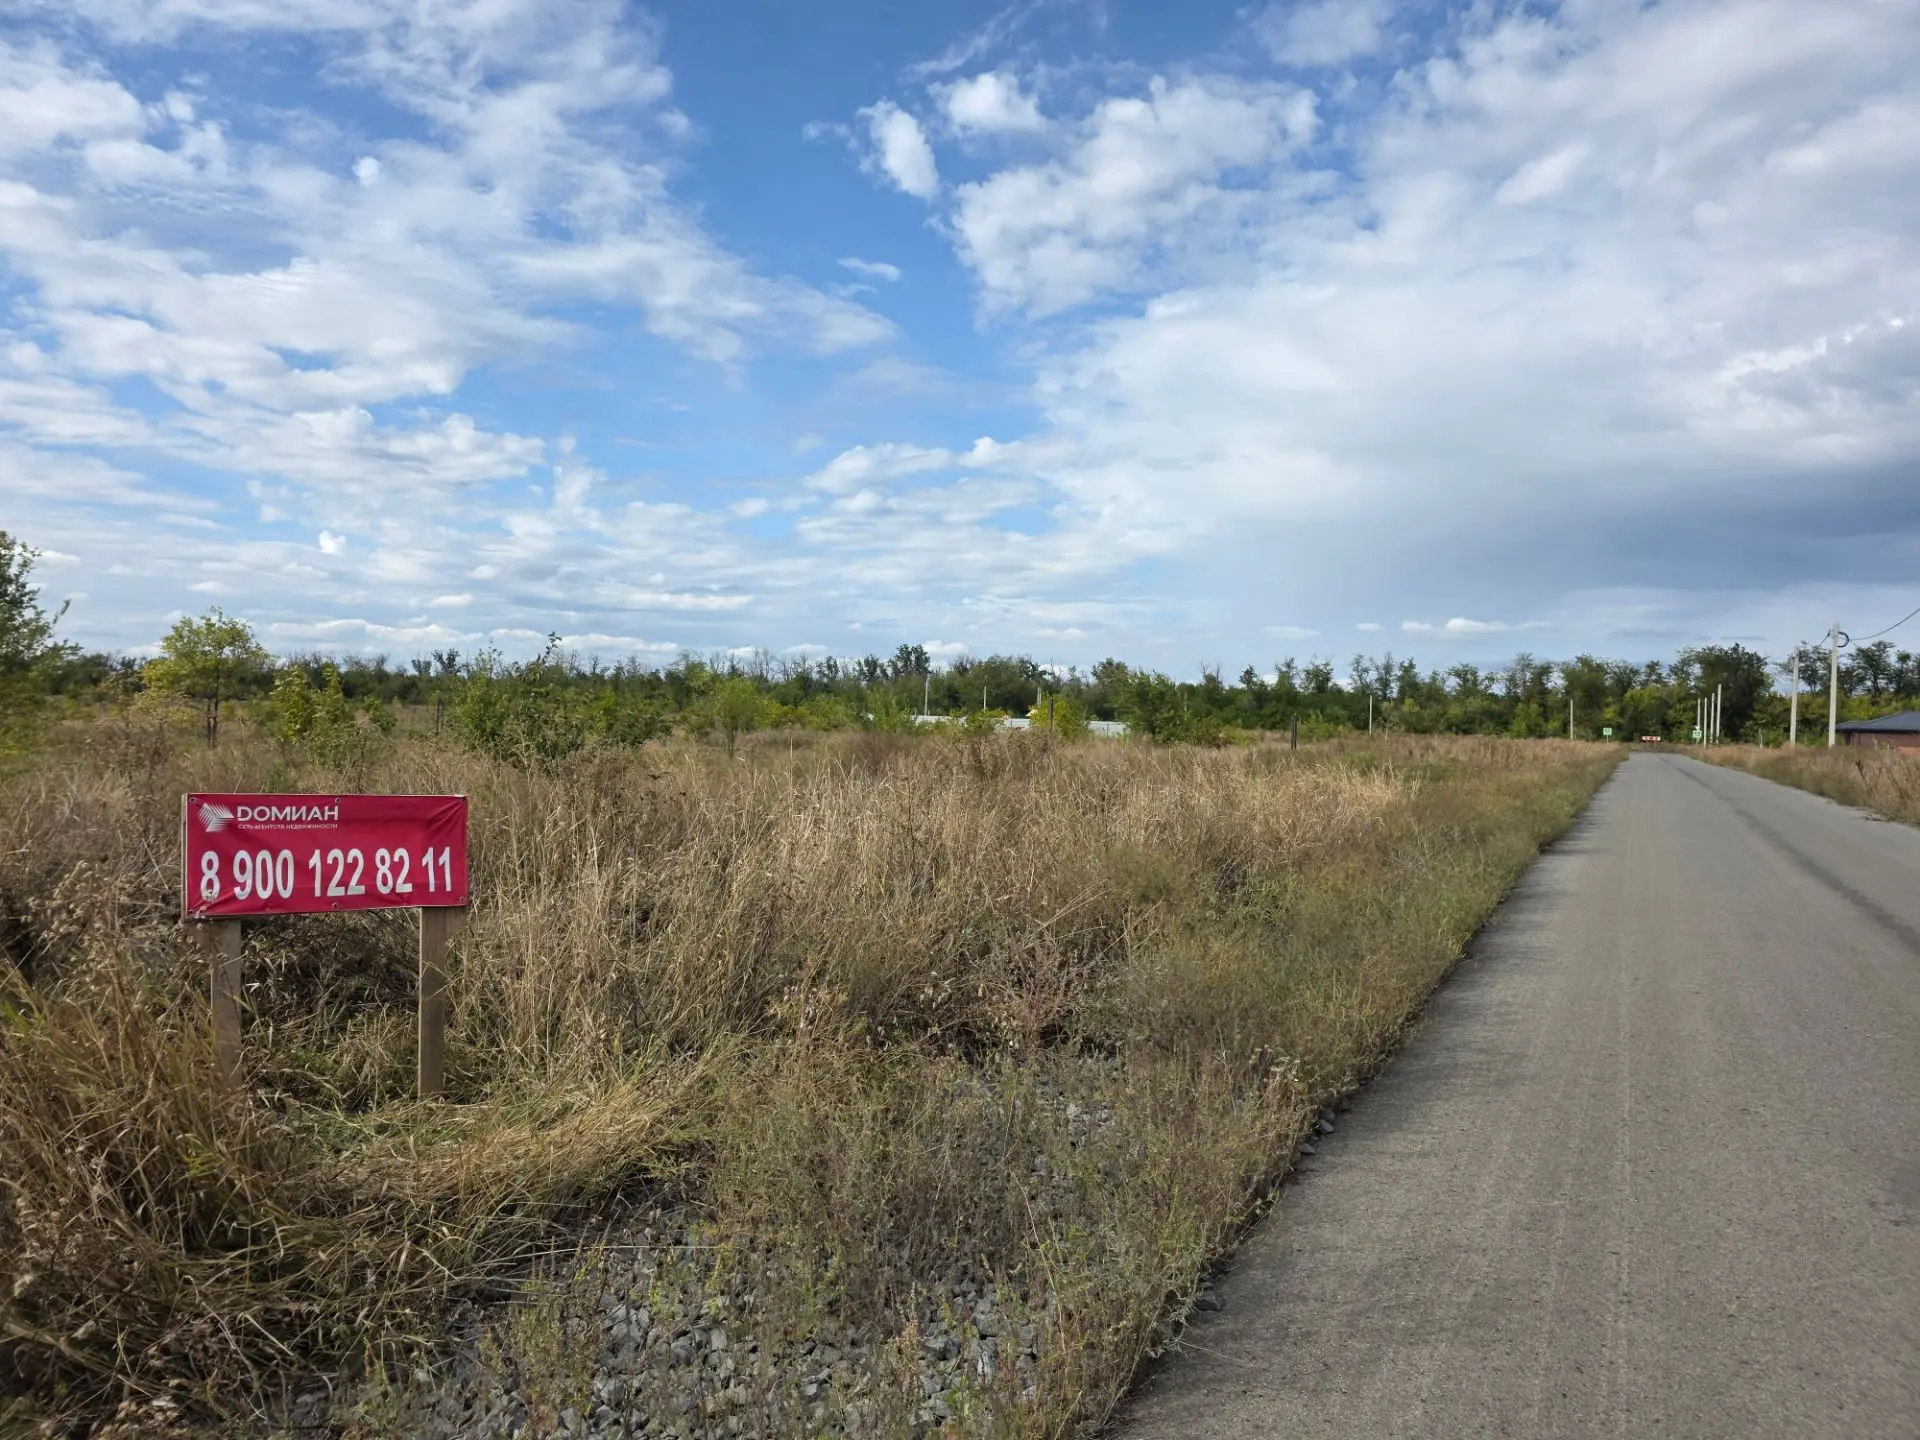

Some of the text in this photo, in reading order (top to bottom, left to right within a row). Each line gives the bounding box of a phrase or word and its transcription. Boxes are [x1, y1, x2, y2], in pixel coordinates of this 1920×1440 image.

[200, 846, 452, 902] 8 900 122 82 11
